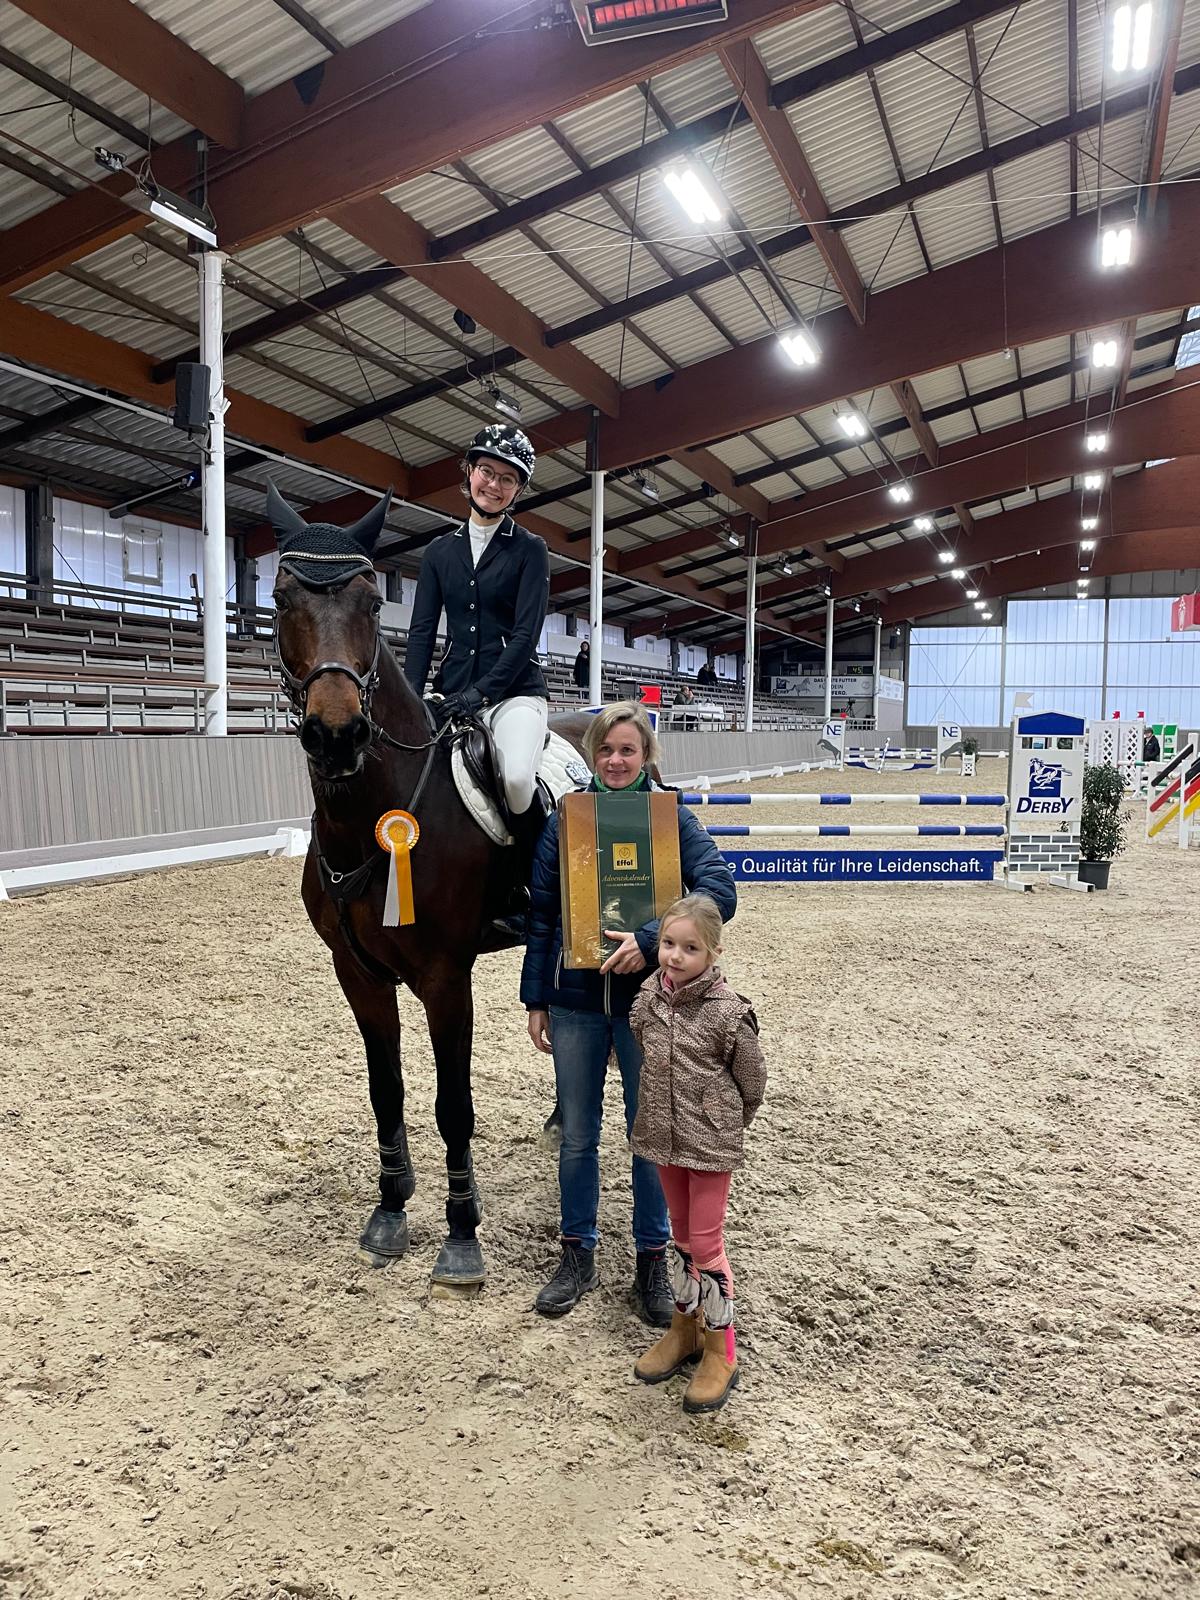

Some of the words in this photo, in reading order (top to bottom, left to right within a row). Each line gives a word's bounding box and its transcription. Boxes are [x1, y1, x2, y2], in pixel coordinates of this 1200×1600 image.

[826, 724, 842, 736] NE
[942, 726, 959, 738] NE
[1016, 797, 1075, 814] DERBY
[616, 859, 633, 867] Effol
[742, 858, 808, 873] Qualität
[812, 858, 836, 873] für
[841, 858, 873, 873] Ihre
[878, 858, 984, 873] Leidenschaft.
